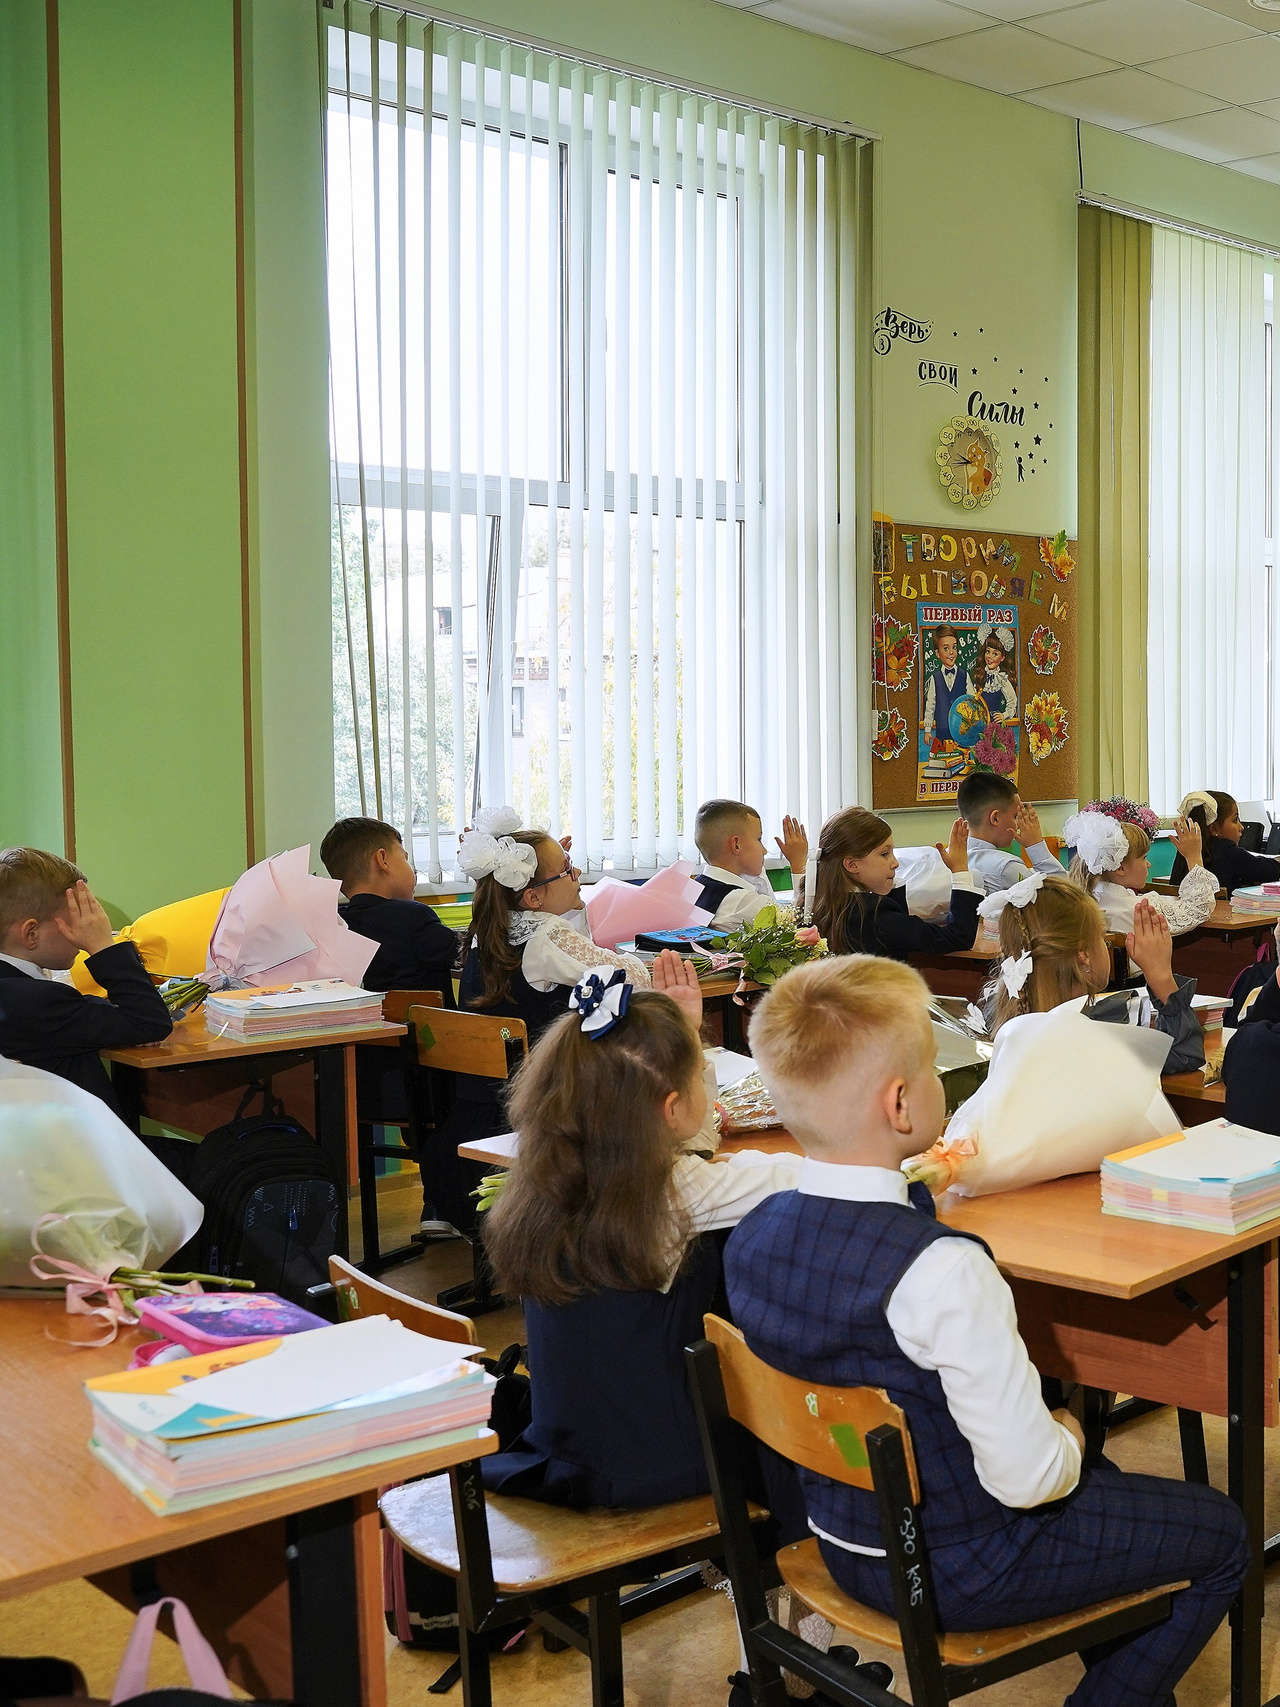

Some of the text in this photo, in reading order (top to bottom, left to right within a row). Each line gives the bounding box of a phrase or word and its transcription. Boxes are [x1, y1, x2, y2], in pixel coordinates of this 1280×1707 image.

[901, 533, 1022, 574] ТВОРИМ
[922, 604, 1013, 624] ПЕРВЫЙ РАЗ
[919, 783, 927, 794] В
